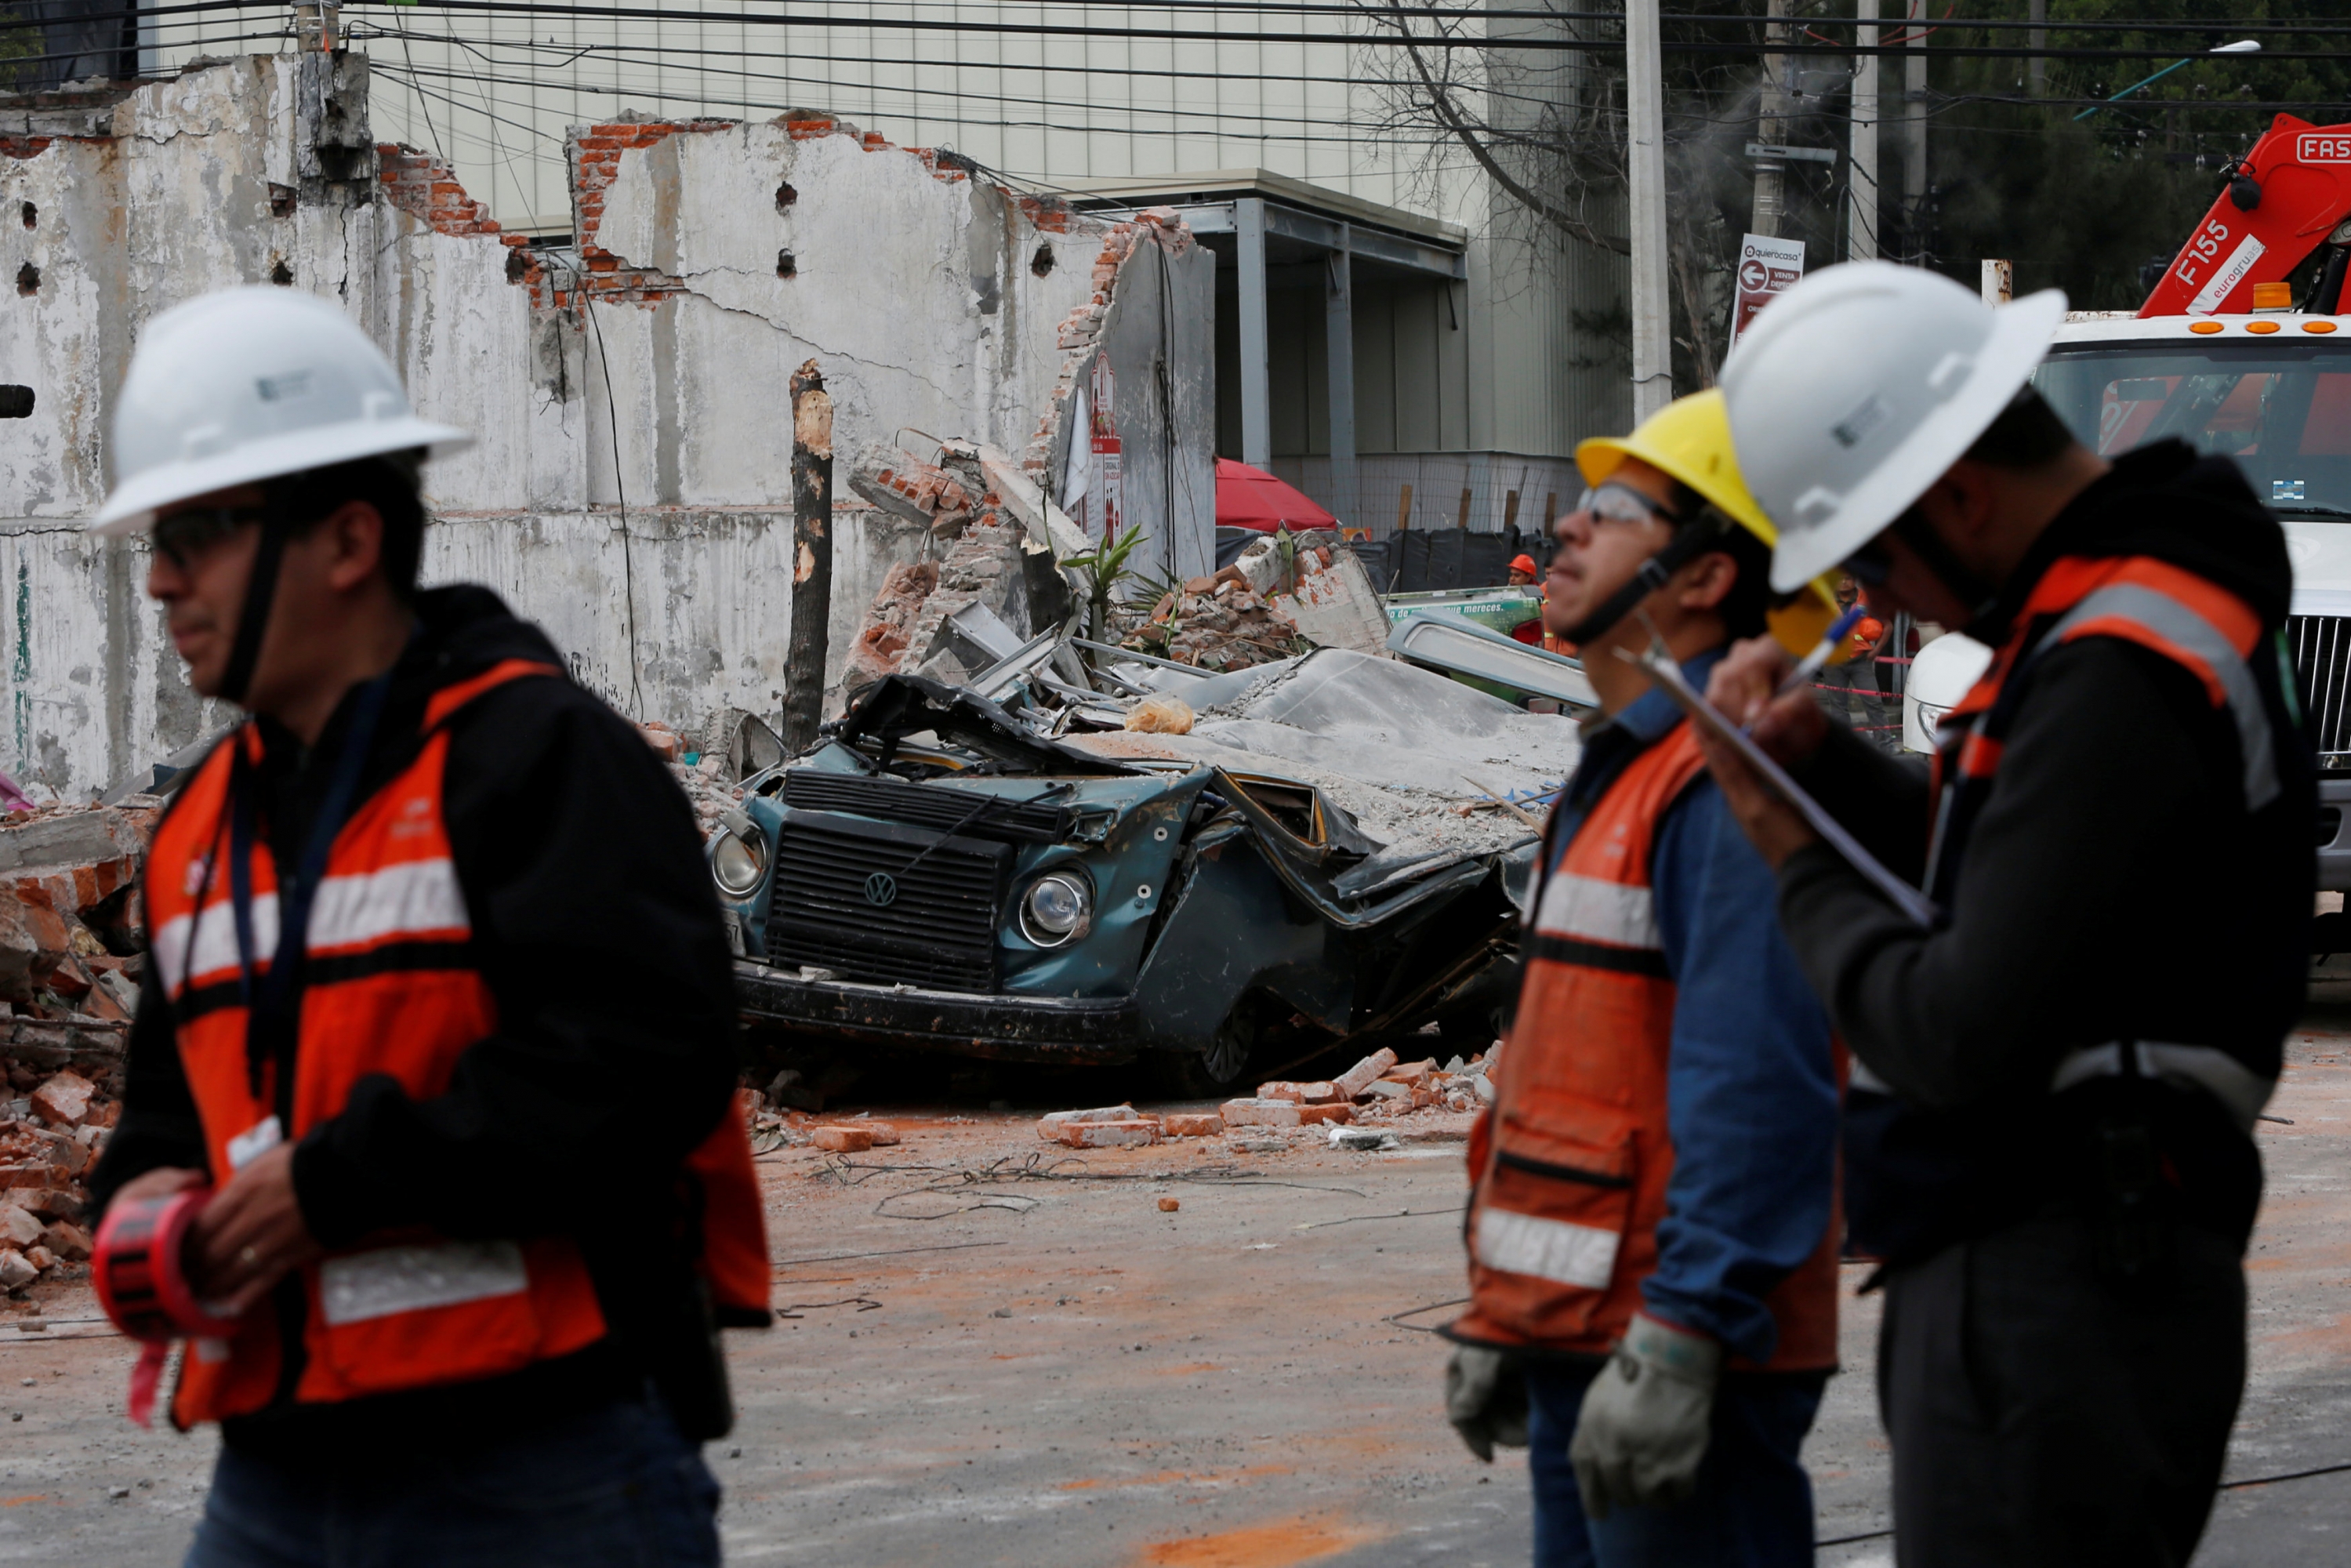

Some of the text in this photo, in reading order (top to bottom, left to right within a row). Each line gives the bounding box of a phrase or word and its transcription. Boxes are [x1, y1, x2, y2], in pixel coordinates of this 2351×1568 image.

[1755, 249, 1798, 261] quierocasa
[2175, 219, 2229, 286] F155
[1774, 271, 1795, 280] VENTA
[2213, 243, 2261, 299] eurogruas
[1398, 608, 1409, 618] de
[1464, 604, 1504, 613] mereces.
